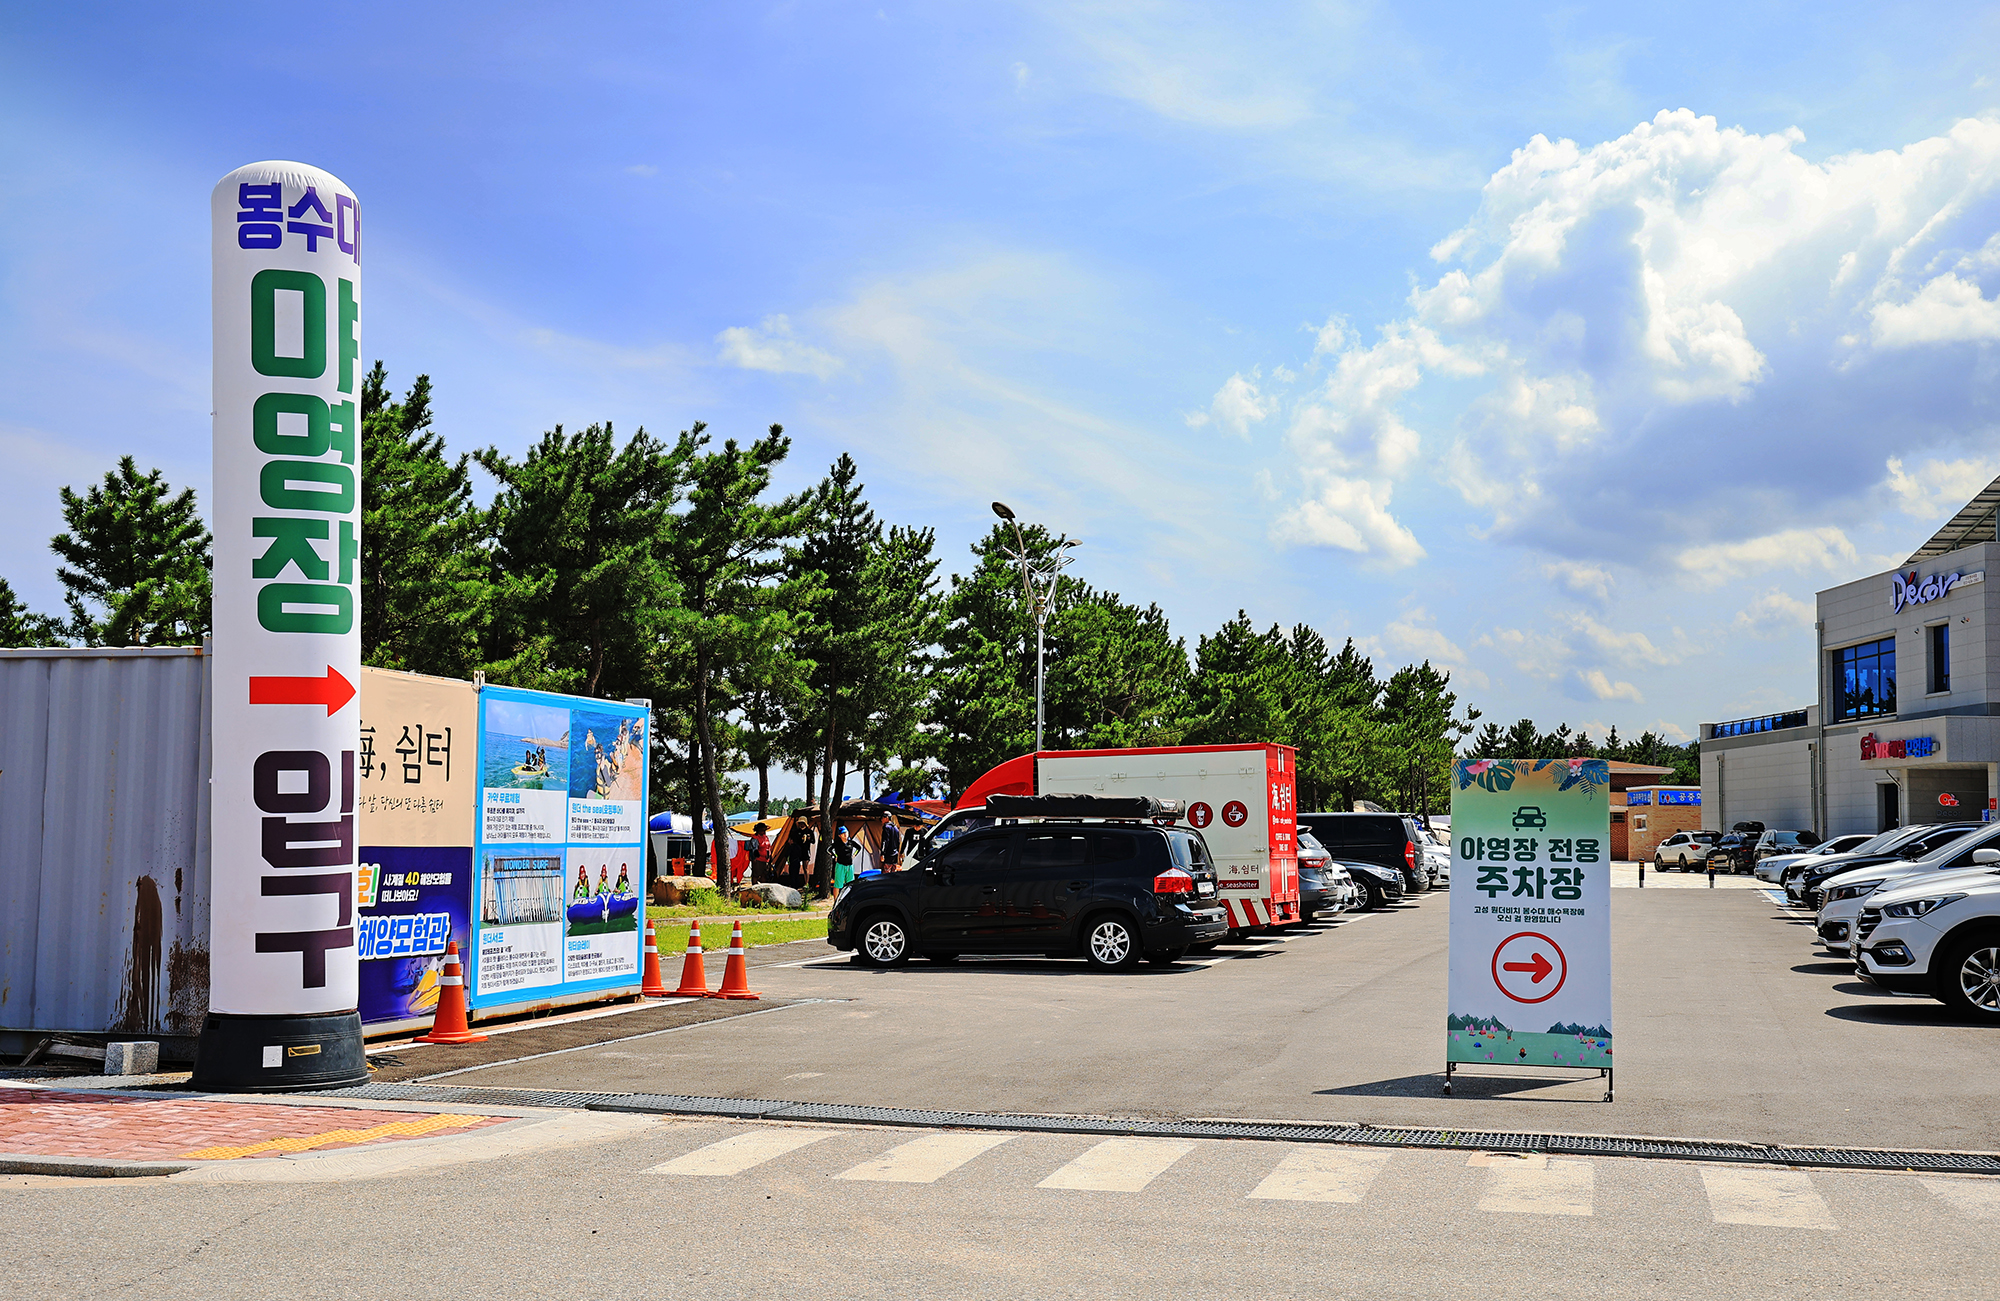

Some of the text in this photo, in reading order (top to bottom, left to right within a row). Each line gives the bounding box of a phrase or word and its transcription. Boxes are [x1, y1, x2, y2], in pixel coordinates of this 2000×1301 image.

[236, 181, 361, 266] 봉수대
[251, 268, 359, 635] 야영장
[1891, 571, 1961, 614] Décor
[395, 724, 451, 784] 쉼터
[582, 804, 591, 813] the
[1460, 836, 1600, 863] 야영장 전용
[253, 749, 355, 989] 입구
[503, 859, 549, 870] WONDER SURF
[405, 871, 420, 886] 4D
[1476, 866, 1585, 900] 주차장
[381, 889, 419, 902] 떠나보아요!
[1474, 905, 1489, 914] 고성
[1491, 906, 1521, 915] 원더비치
[1496, 914, 1512, 923] 오신
[1524, 915, 1562, 924] 환영합니다
